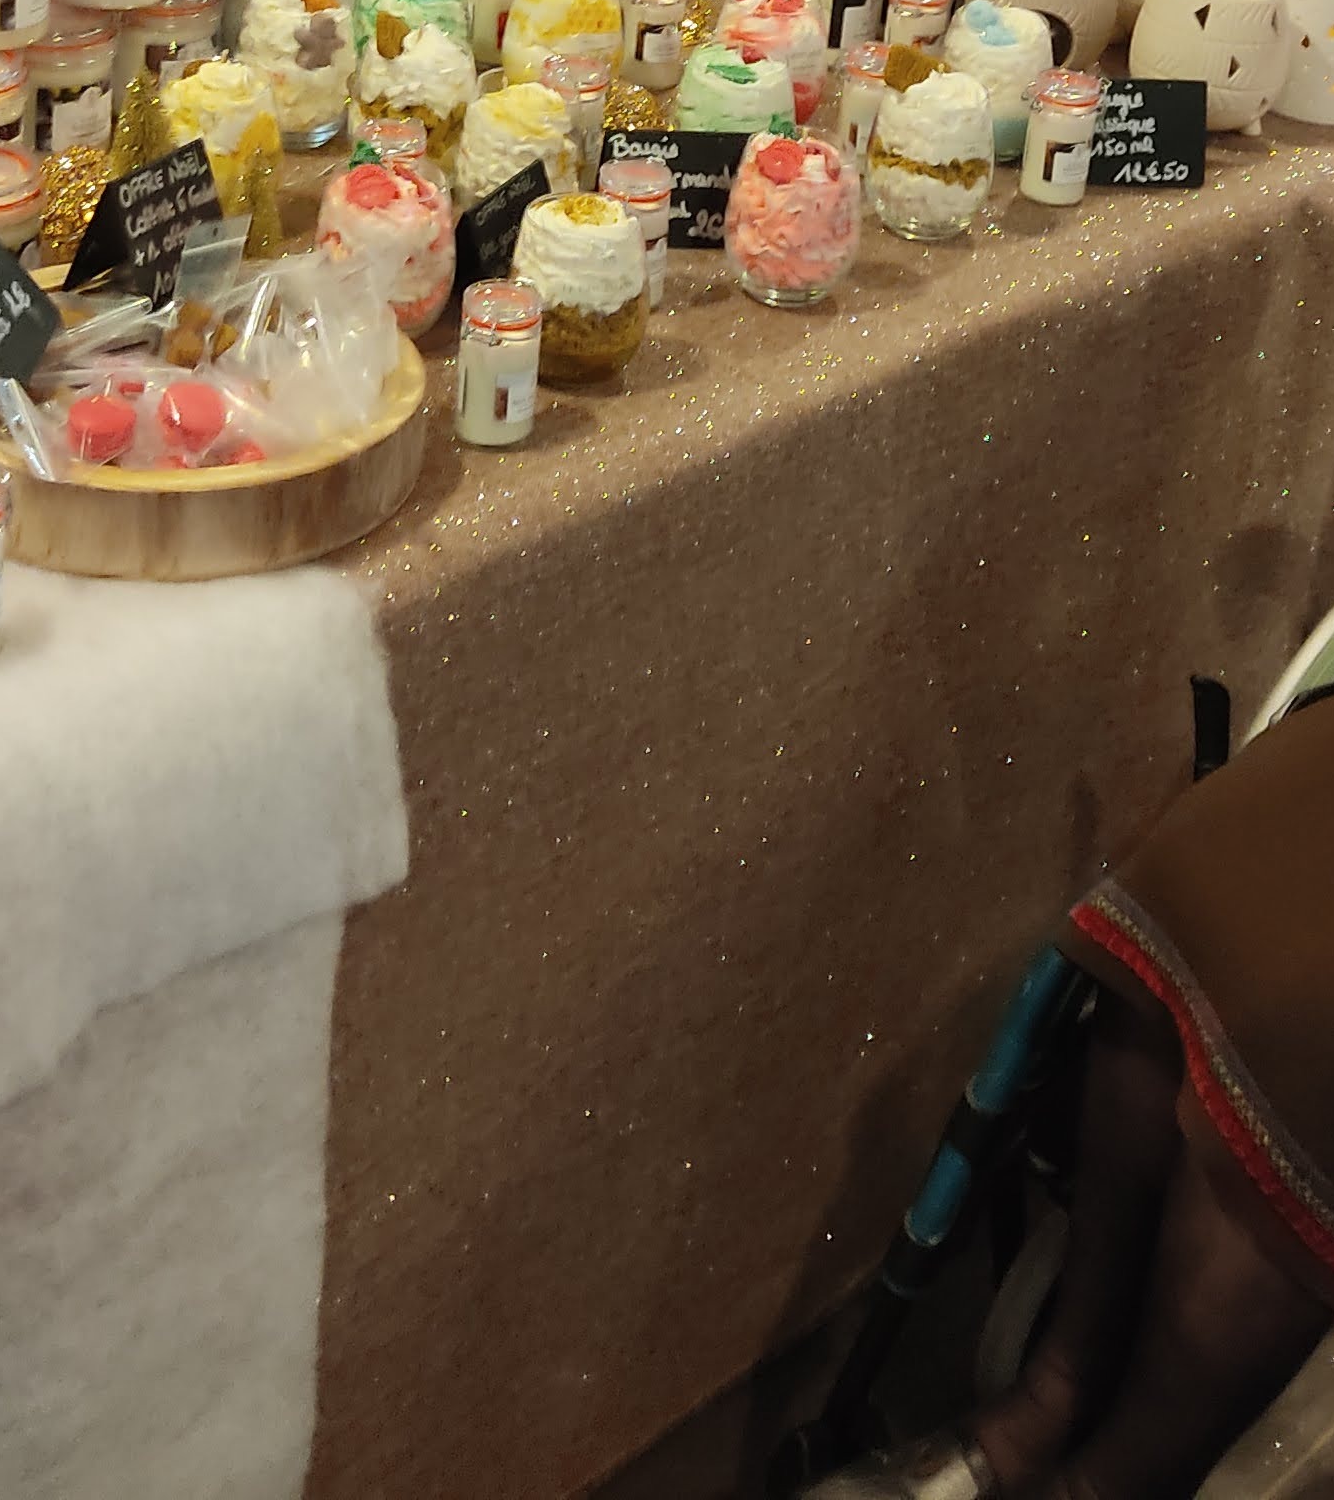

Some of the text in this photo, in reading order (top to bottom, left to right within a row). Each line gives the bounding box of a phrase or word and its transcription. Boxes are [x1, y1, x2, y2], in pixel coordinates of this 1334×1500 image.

[1090, 134, 1156, 157] 150 ml
[119, 149, 209, 209] OFFRE NOËL
